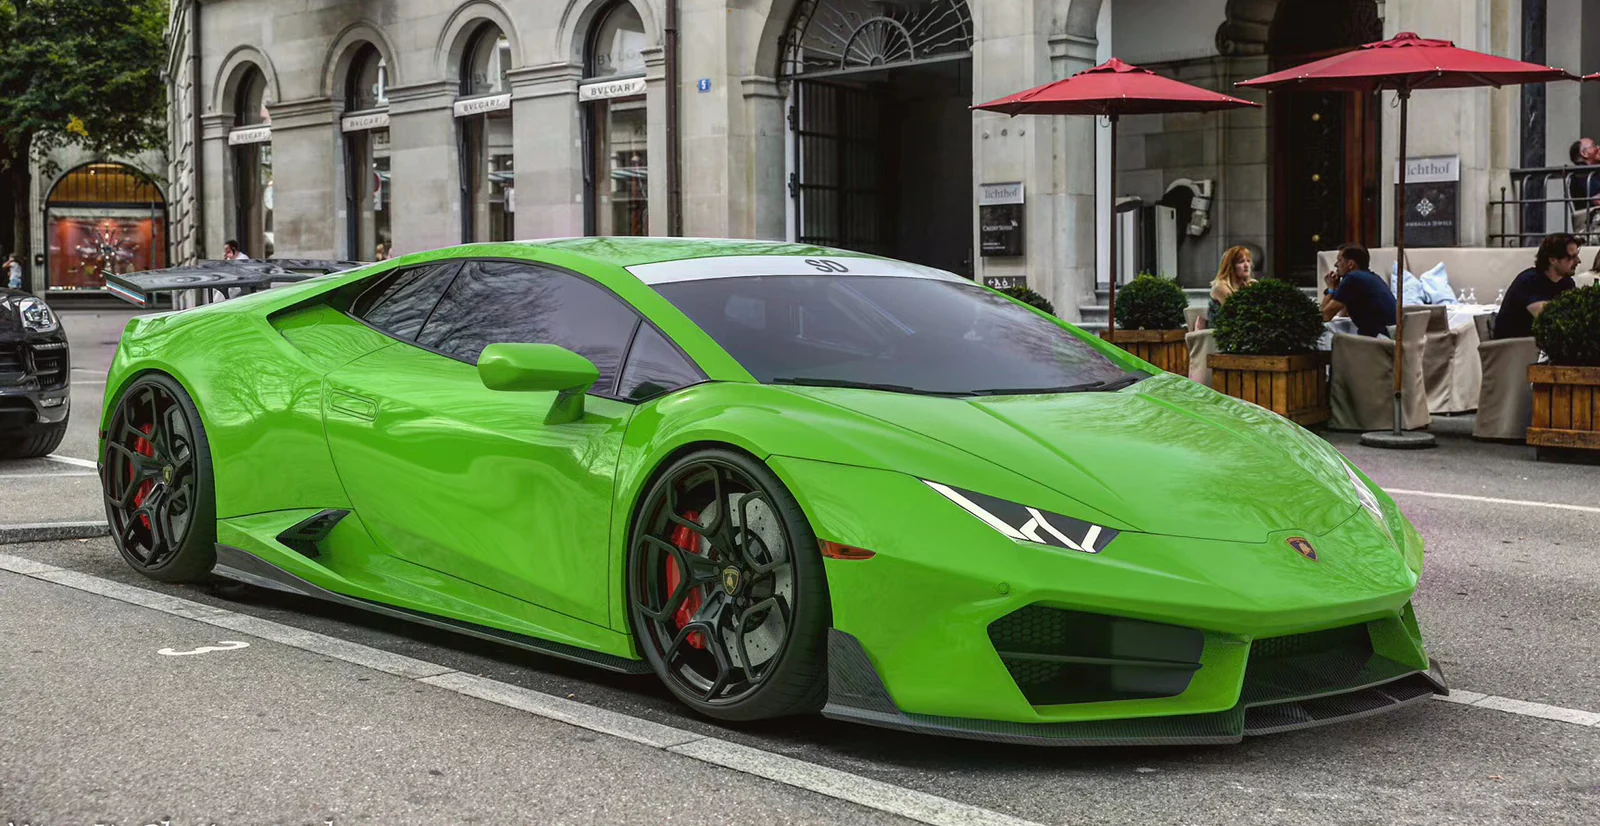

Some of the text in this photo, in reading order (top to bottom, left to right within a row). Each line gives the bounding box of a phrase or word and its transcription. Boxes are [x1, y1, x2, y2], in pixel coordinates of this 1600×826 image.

[591, 83, 636, 96] BVLGARI
[463, 100, 500, 112] BVLGARI
[350, 116, 383, 128] BVLGARI
[1406, 162, 1451, 176] ichthof
[984, 187, 1018, 199] lichthof
[157, 640, 250, 656] 3
